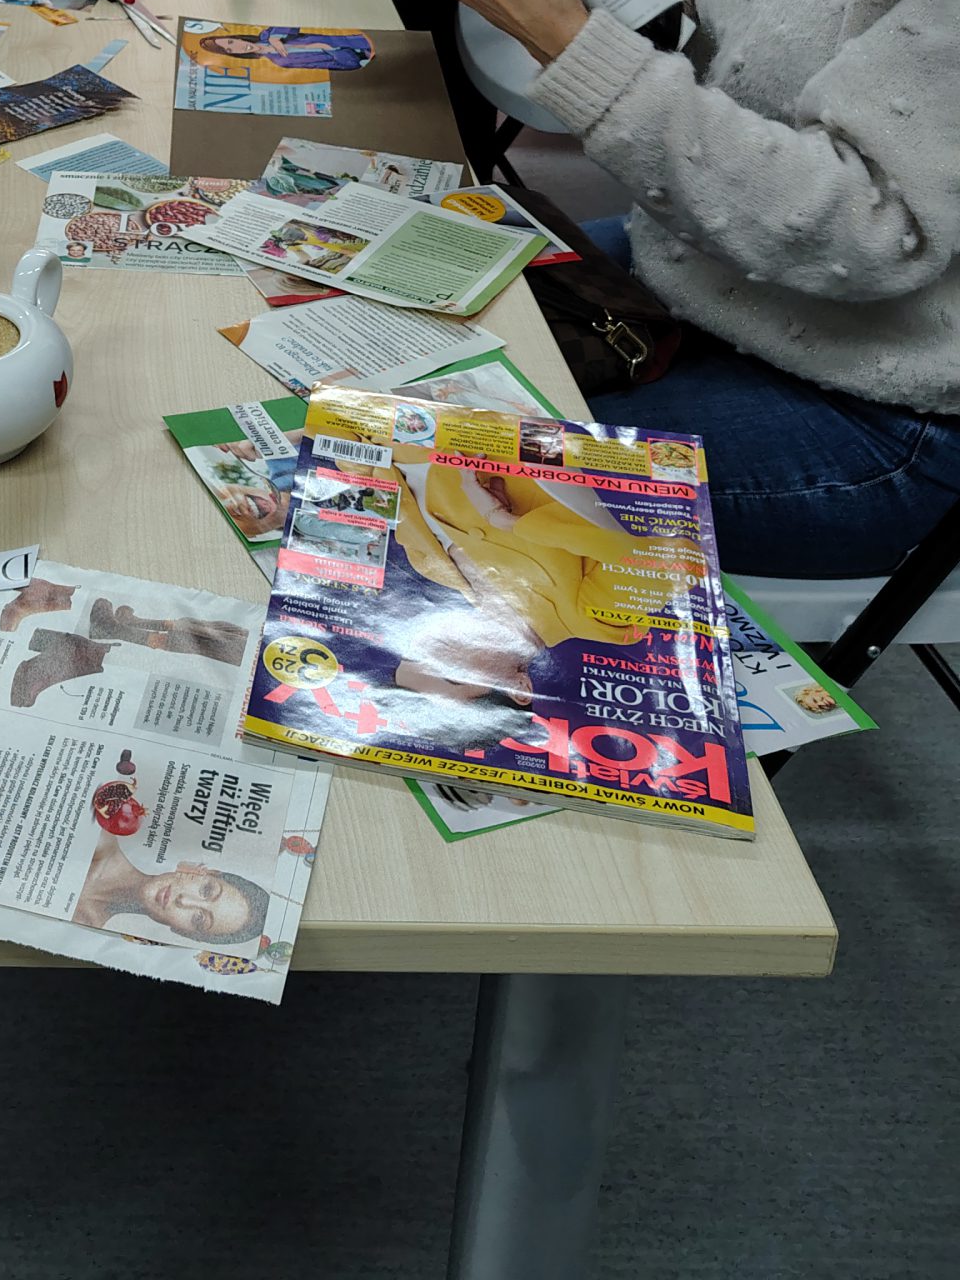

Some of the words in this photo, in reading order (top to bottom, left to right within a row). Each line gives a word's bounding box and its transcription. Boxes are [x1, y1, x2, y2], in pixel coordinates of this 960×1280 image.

[204, 65, 251, 112] NIE
[282, 334, 314, 359] trudne?
[283, 346, 320, 376] Dlaczego
[310, 354, 332, 372] takie
[235, 405, 249, 419] bio
[248, 406, 282, 444] enerBiO!
[245, 421, 274, 456] Ulubione
[448, 441, 484, 451] BROWNIE
[449, 436, 494, 448] SPOSOBÓW
[278, 446, 289, 455] to
[434, 453, 510, 474] HUMOR
[515, 464, 586, 485] DOBRY
[590, 475, 621, 490] NA
[627, 478, 689, 499] MENU
[593, 498, 654, 516] asertywności
[633, 496, 684, 513] ekspertem
[656, 507, 691, 521] Trening
[619, 511, 644, 524] NIE
[646, 514, 700, 532] MÓWIĆ
[629, 522, 648, 533] się
[650, 522, 701, 540] Uczymy
[631, 546, 677, 562] ochronią
[648, 543, 674, 554] kości
[676, 546, 704, 559] twoje
[678, 553, 705, 566] które
[601, 561, 681, 582] DOBRYCH
[684, 572, 706, 588] 10
[612, 582, 638, 594] tym!
[648, 589, 663, 597] mi
[281, 596, 320, 610] kobiety
[322, 594, 351, 606] mojej
[322, 604, 347, 614] mnie
[613, 598, 661, 615] ukrywać
[628, 593, 662, 606] wieku
[279, 604, 353, 625] Ukształtowały
[590, 607, 631, 624] ŻYCIA
[633, 615, 644, 624] Z
[693, 611, 710, 621] Nie
[270, 655, 296, 674] 29
[294, 646, 330, 684] 3
[582, 664, 645, 684] DODATKI
[701, 670, 716, 682] W
[578, 675, 723, 719] KOLOR!
[584, 701, 644, 727] ŻYJE
[648, 711, 726, 738] NIECH
[45, 734, 56, 746] SKIN
[93, 743, 105, 756] Skin
[40, 745, 52, 758] CARE
[374, 748, 433, 768] WIĘCEJ
[514, 753, 545, 763] MARZEC
[30, 757, 48, 787] WYPEŁNIACZ
[88, 756, 100, 769] Care
[437, 759, 507, 779] JESZCZE
[516, 758, 545, 769] 03/2022
[79, 769, 96, 798] Wypełniacz
[154, 759, 177, 803] odmładzająca
[172, 762, 191, 796] Szwedzka,
[213, 771, 245, 801] niż
[511, 772, 588, 794] KOBIETY!
[571, 760, 708, 801] świat
[18, 786, 37, 819] KOLAGENOWY
[181, 766, 220, 826] twarzy
[593, 787, 646, 806] ŚWIAT
[68, 798, 86, 831] Kolagenowy
[147, 802, 165, 830] dojrzałą
[160, 795, 182, 837] innowacyjna
[234, 779, 272, 835] Więcej
[651, 798, 705, 815] NOWY
[12, 823, 24, 835] JEST
[200, 799, 238, 855] lifting
[58, 831, 75, 861] skutecznie
[141, 828, 157, 848] skórę
[0, 834, 19, 866] PRODUKTEM
[153, 836, 171, 865] formuła
[50, 861, 66, 885] pomaga
